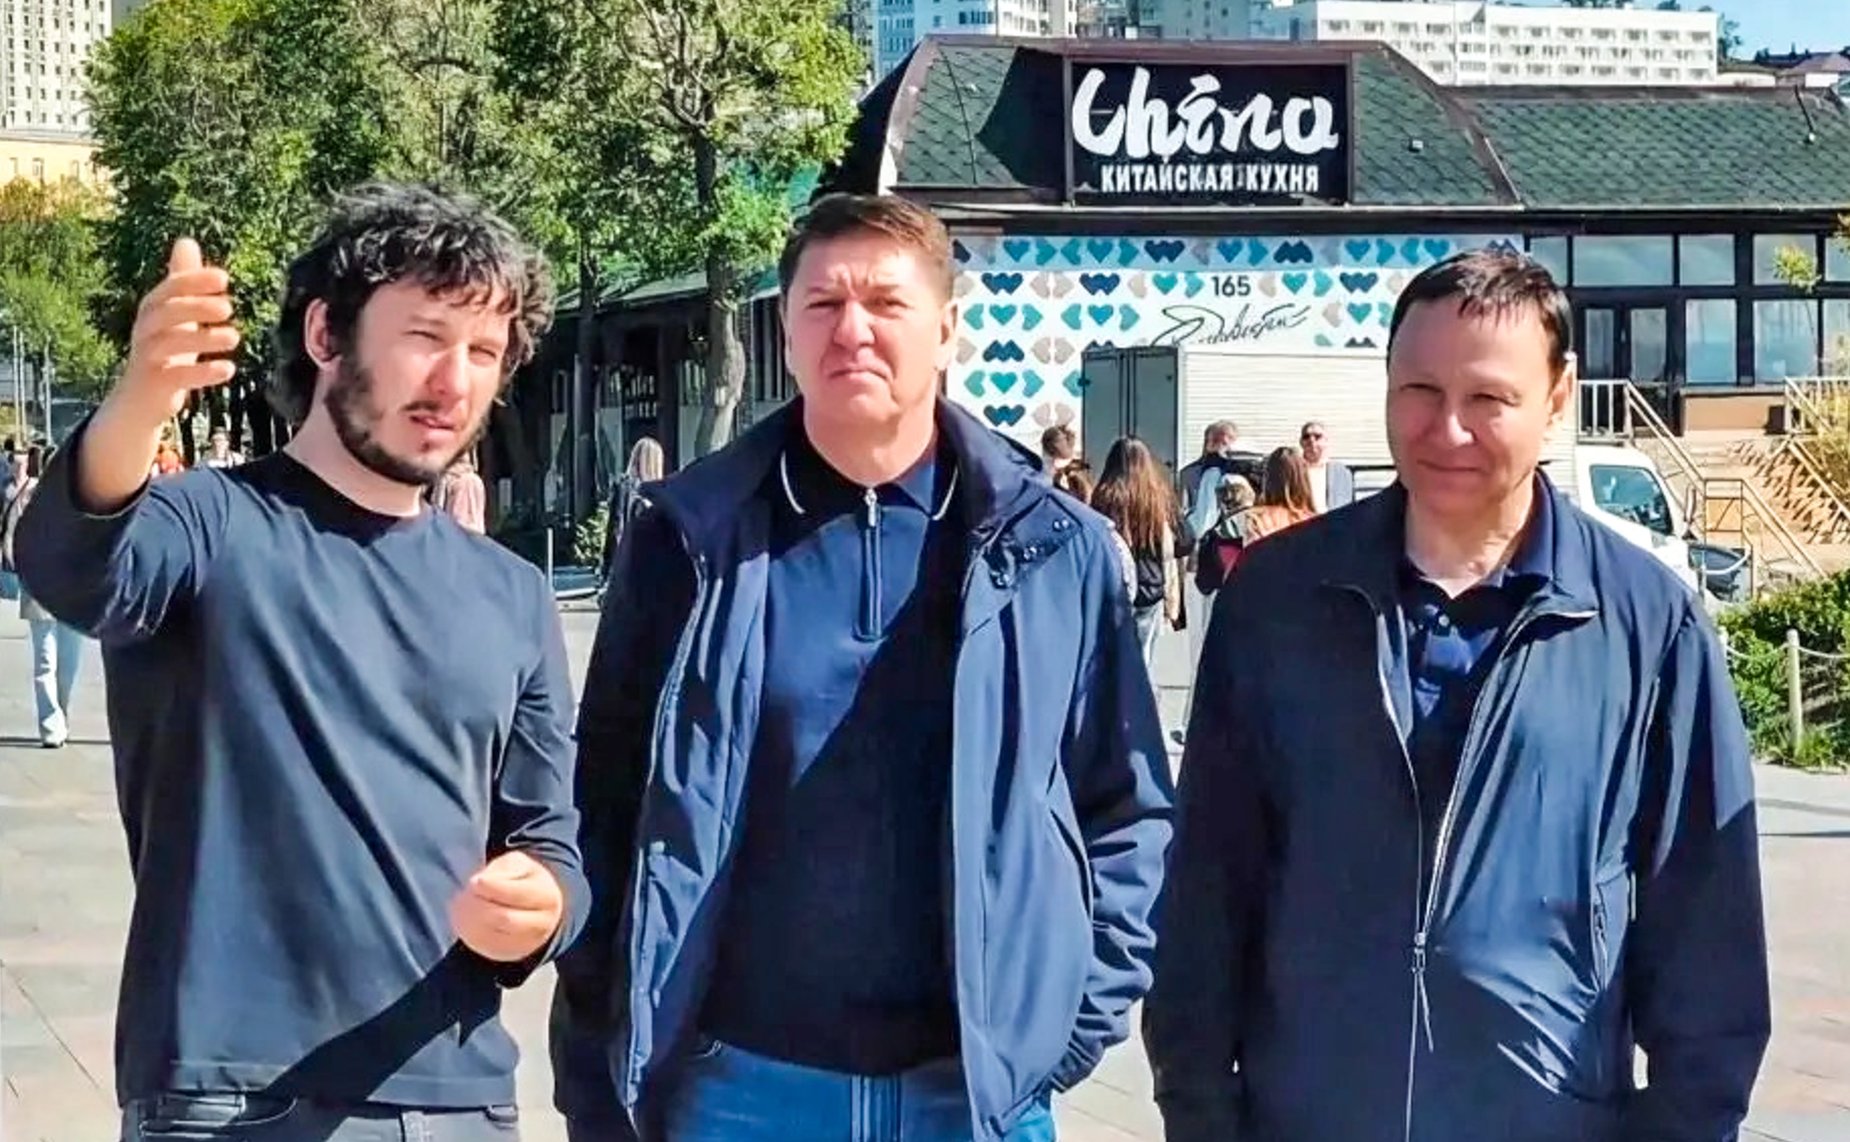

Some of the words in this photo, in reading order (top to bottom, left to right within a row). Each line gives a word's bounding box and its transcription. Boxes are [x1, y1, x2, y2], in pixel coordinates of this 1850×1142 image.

[1071, 66, 1340, 158] China
[1100, 162, 1234, 193] КИТАЙСКАЯ
[1246, 163, 1320, 193] КУХНЯ
[1211, 275, 1252, 297] 165
